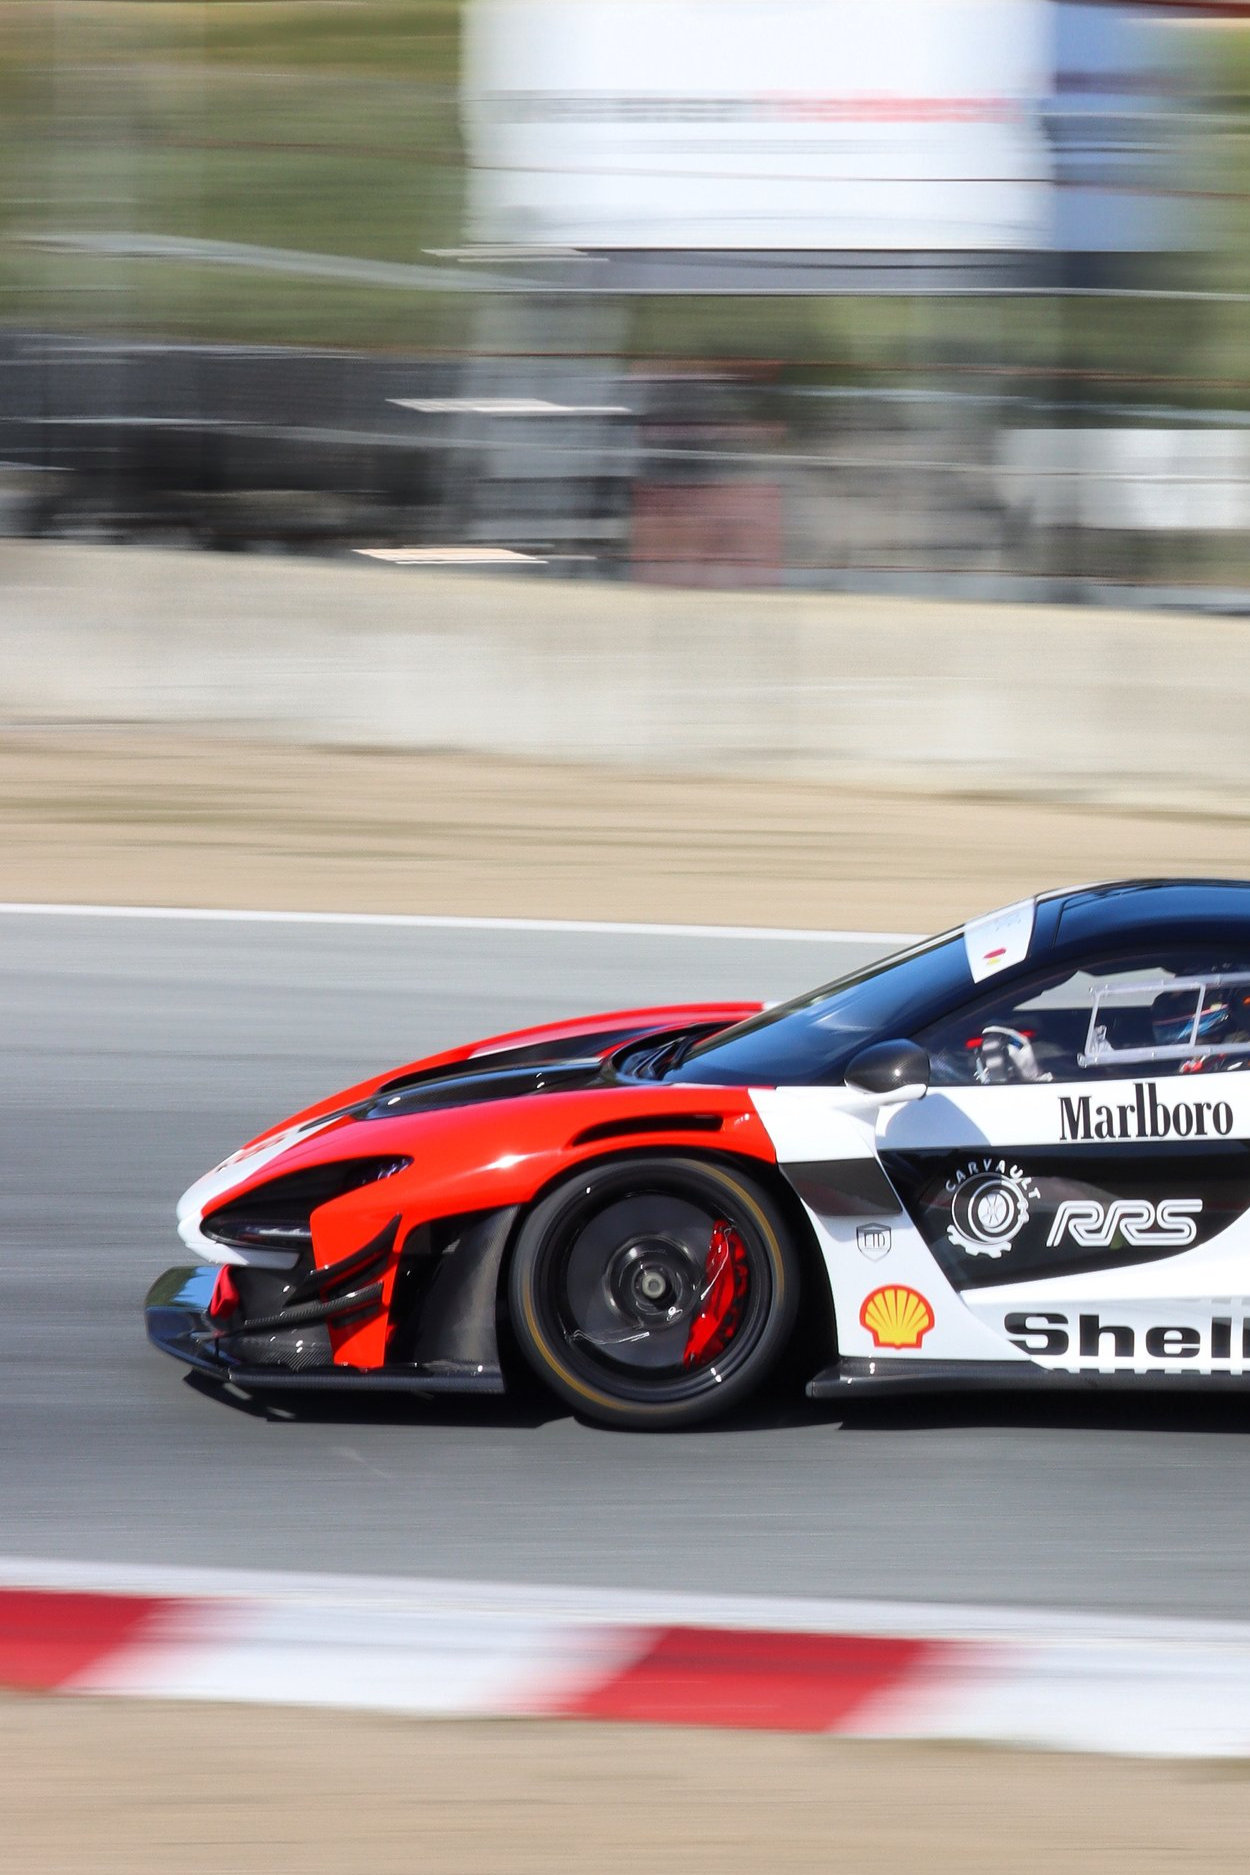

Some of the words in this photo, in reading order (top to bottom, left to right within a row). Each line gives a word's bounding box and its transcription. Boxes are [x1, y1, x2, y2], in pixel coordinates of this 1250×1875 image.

[1058, 1082, 1234, 1141] Marlboro
[945, 1158, 1041, 1199] CARVAULT
[1046, 1198, 1203, 1248] RRS
